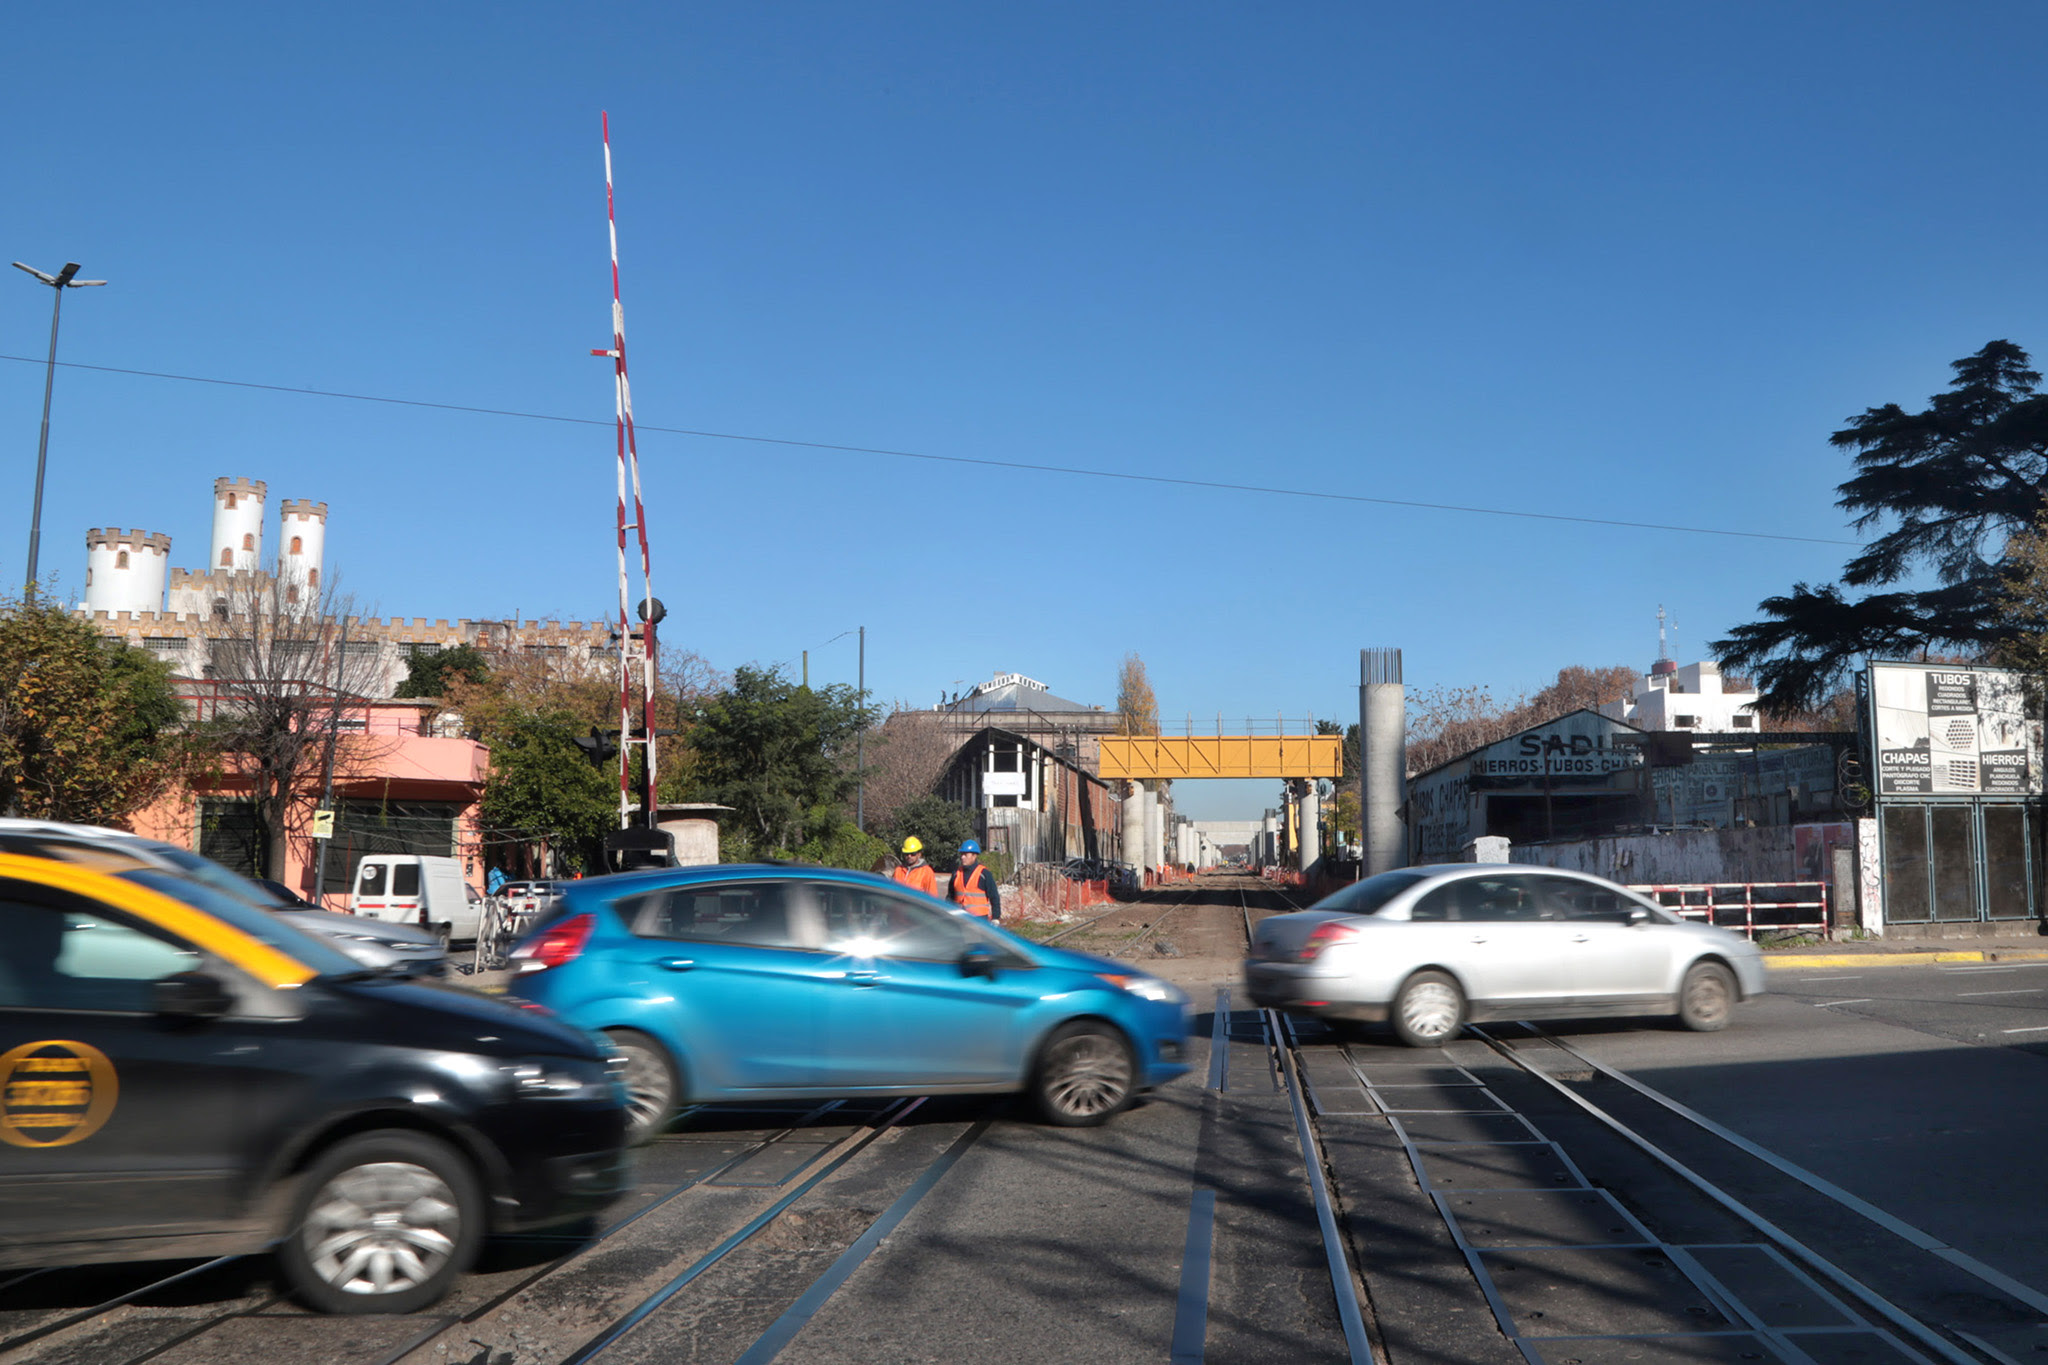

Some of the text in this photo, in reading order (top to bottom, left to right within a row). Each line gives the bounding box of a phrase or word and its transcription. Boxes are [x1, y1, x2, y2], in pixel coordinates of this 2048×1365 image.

[1931, 673, 1971, 685] TUBOS
[1520, 734, 1604, 757] SADI
[1882, 752, 1929, 764] CHAPAS
[1982, 754, 2026, 766] HIERROS
